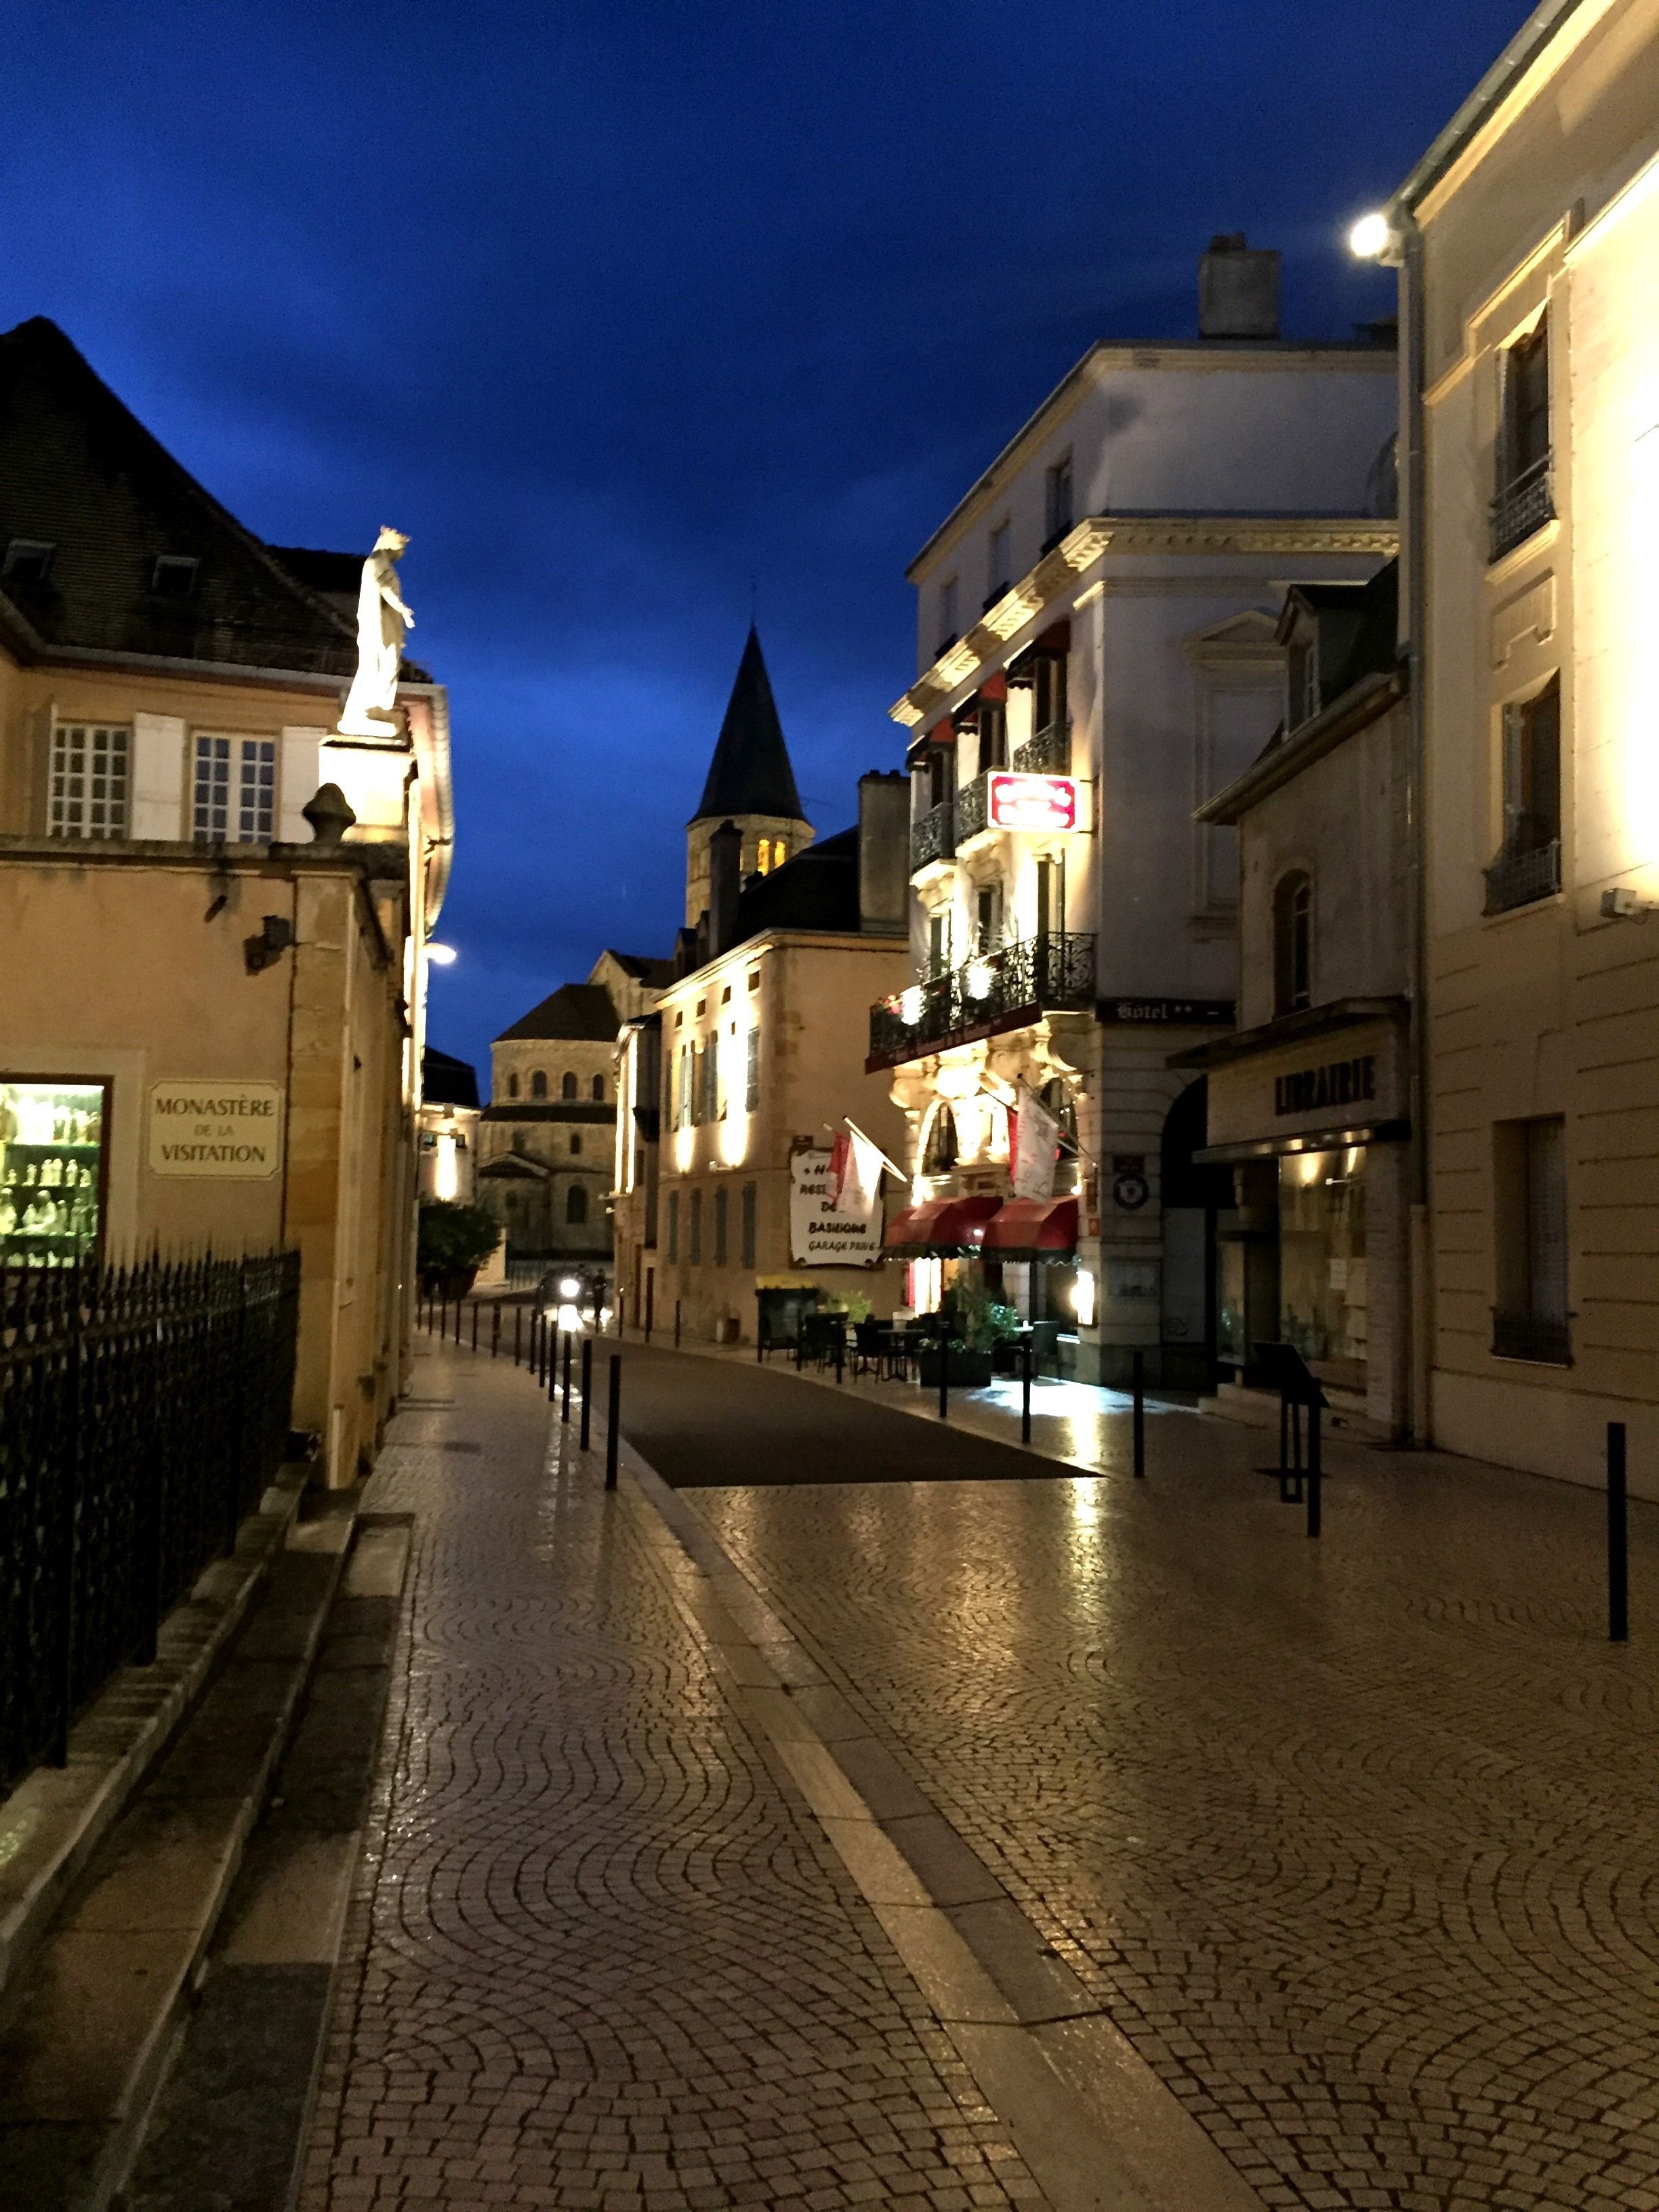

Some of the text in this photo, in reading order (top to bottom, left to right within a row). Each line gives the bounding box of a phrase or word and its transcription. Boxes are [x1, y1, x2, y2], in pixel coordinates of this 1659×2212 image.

[155, 1094, 274, 1117] MONASTÈRE
[193, 1124, 234, 1137] DE LA
[161, 1144, 266, 1162] VISITATION
[808, 1240, 848, 1253] GARAGE
